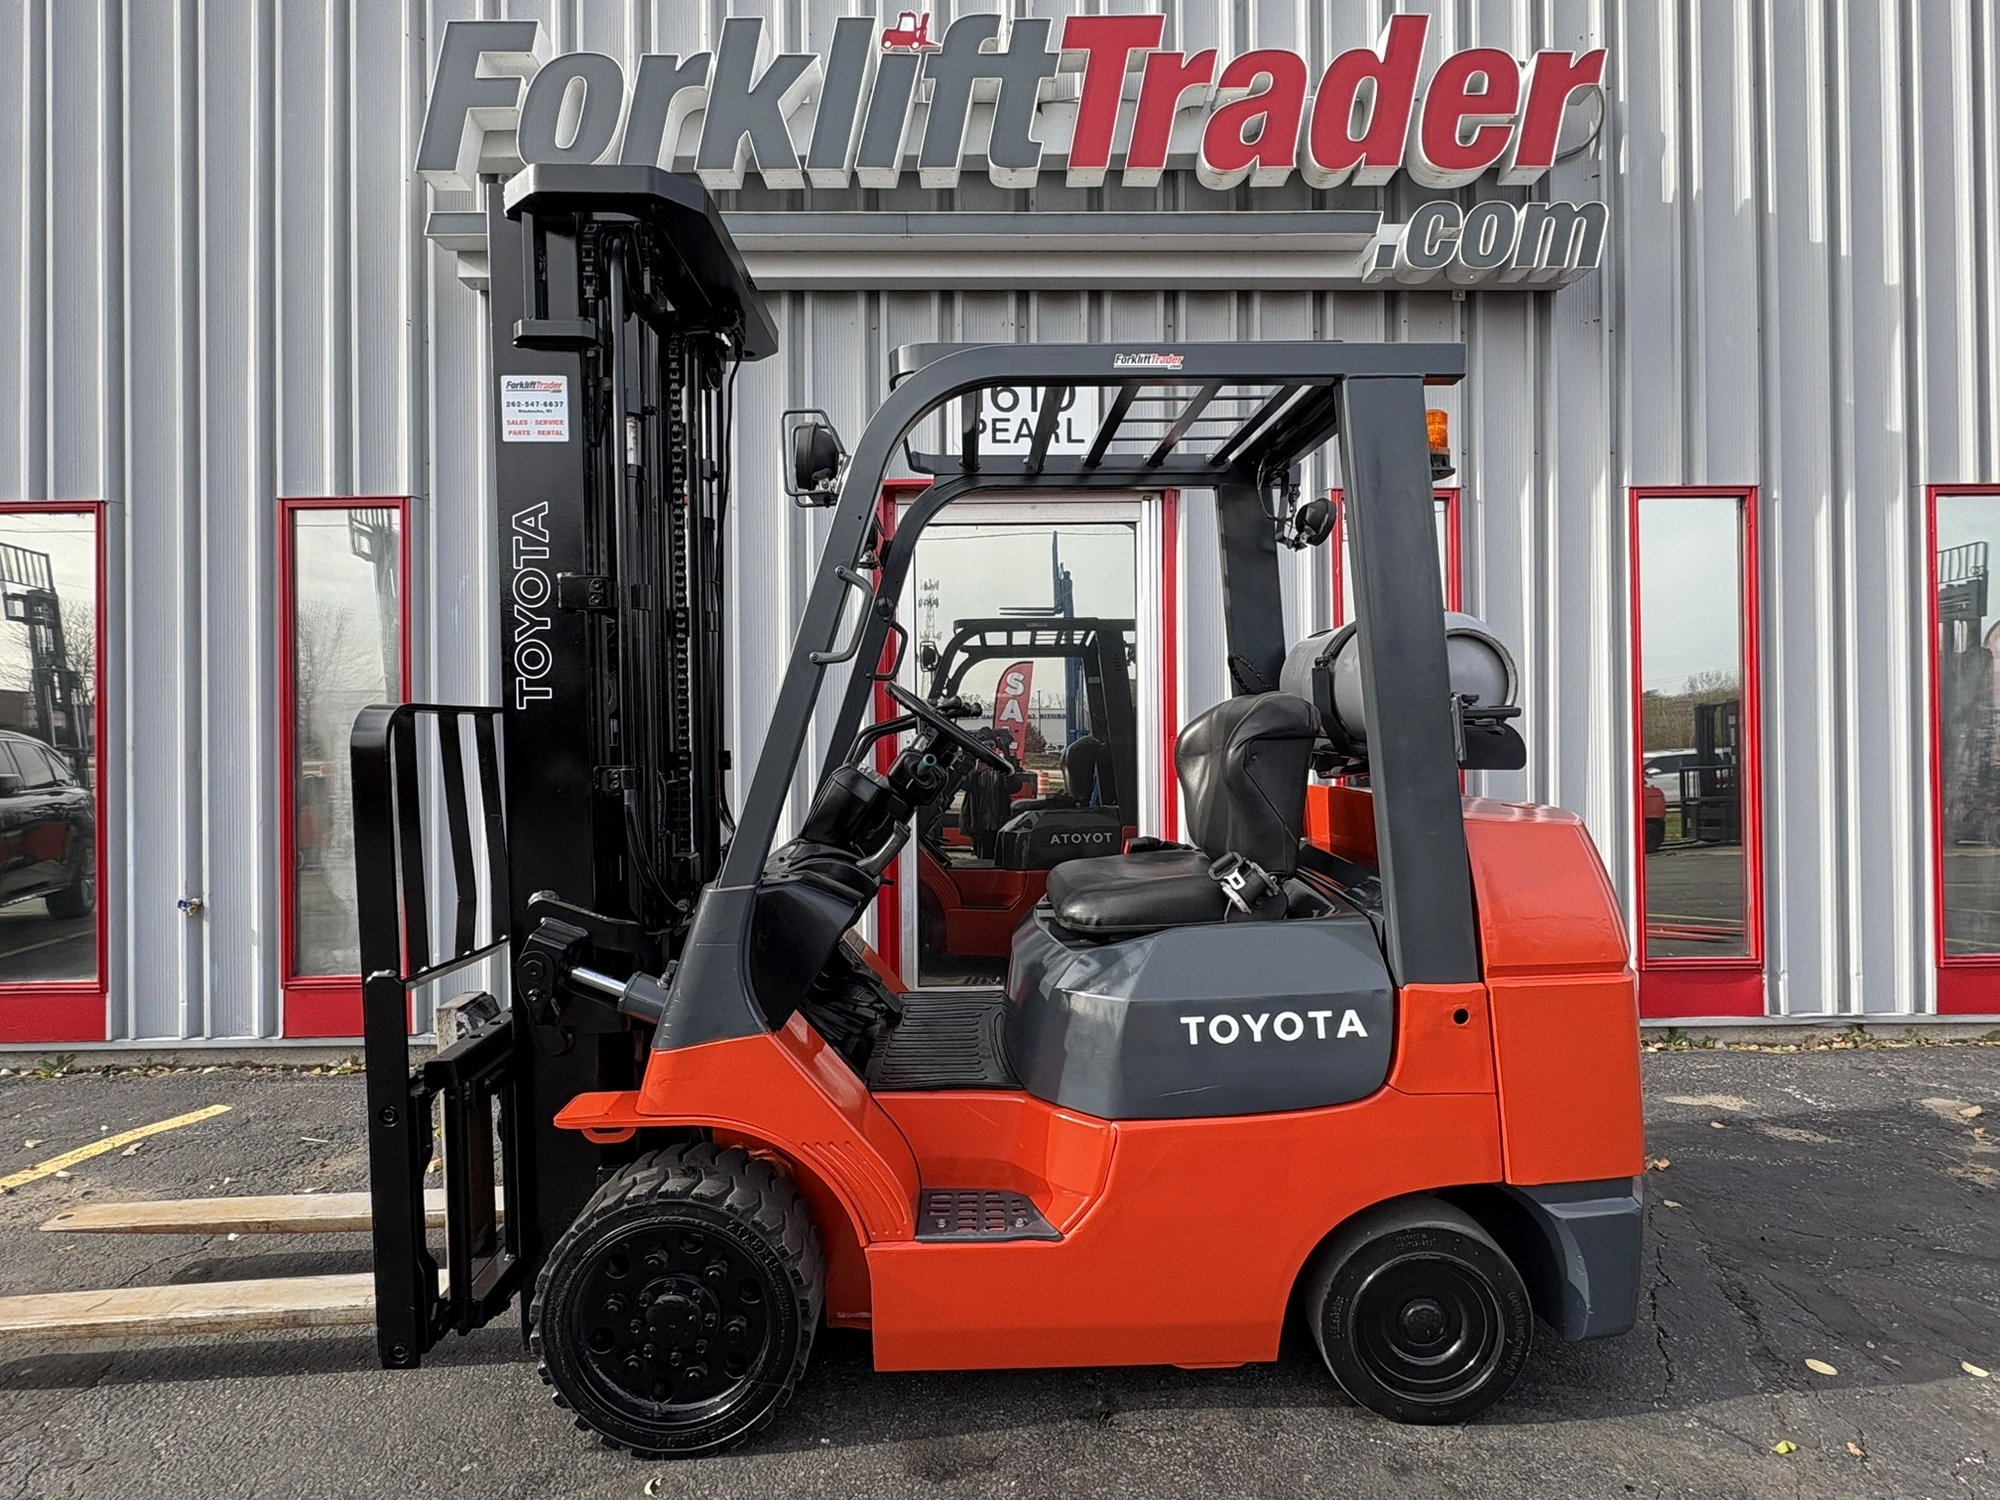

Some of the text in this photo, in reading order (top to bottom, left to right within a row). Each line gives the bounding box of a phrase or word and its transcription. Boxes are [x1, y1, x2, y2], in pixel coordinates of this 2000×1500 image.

[1373, 200, 1609, 270] .com
[512, 501, 552, 710] TOYOTA
[1180, 1009, 1368, 1045] TOYOTA
